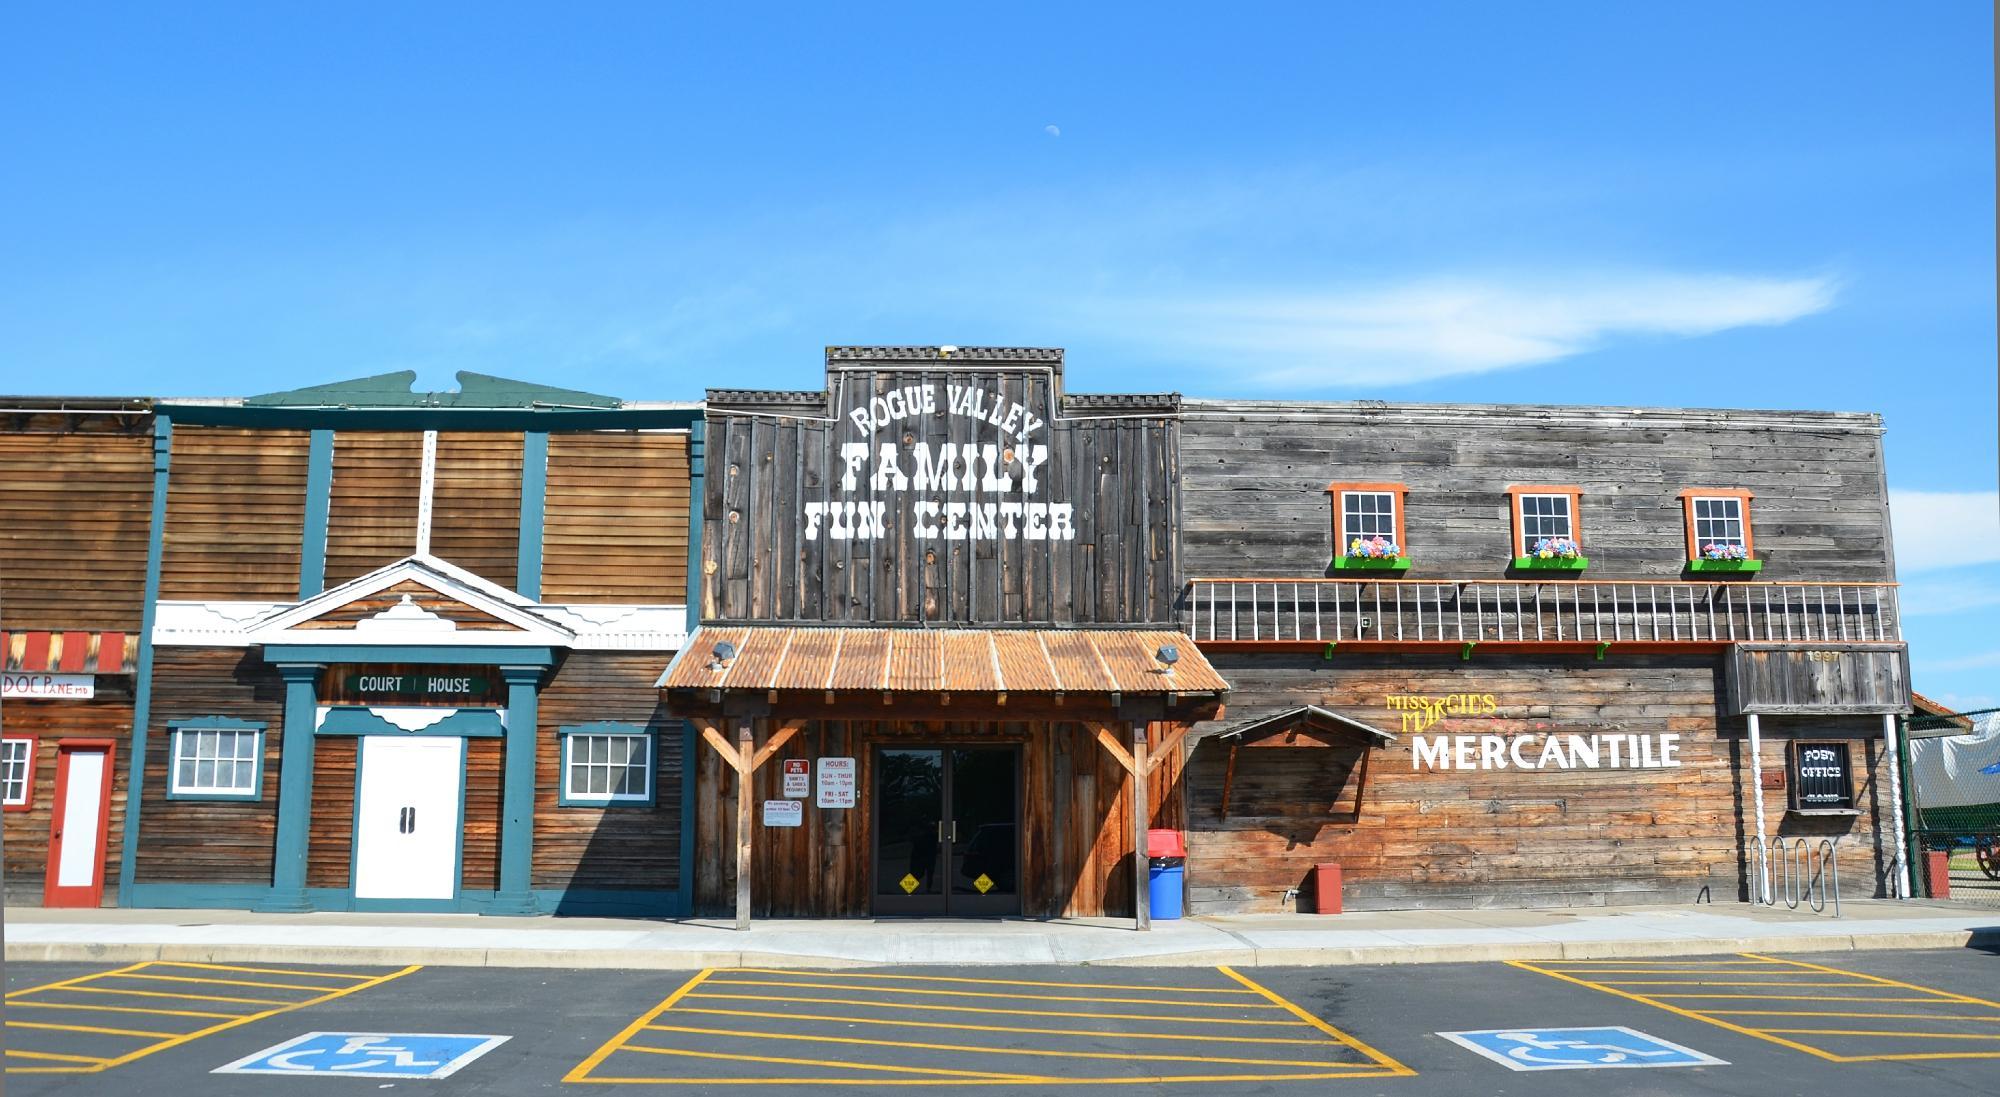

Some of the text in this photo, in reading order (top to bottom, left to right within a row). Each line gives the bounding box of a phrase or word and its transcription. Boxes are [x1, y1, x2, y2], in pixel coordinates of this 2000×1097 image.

[849, 384, 1043, 441] ROGUE VALLEY
[841, 442, 1048, 493] FAMILY
[804, 501, 1076, 541] FUN CENTER
[1808, 651, 1840, 663] 1997
[360, 676, 471, 692] COURT HOUSE
[1386, 694, 1429, 710] MISS
[1412, 733, 1681, 770] MERCANTILE
[1804, 749, 1836, 762] POST
[825, 760, 849, 768] HOURS:
[1801, 766, 1842, 778] OFFICE
